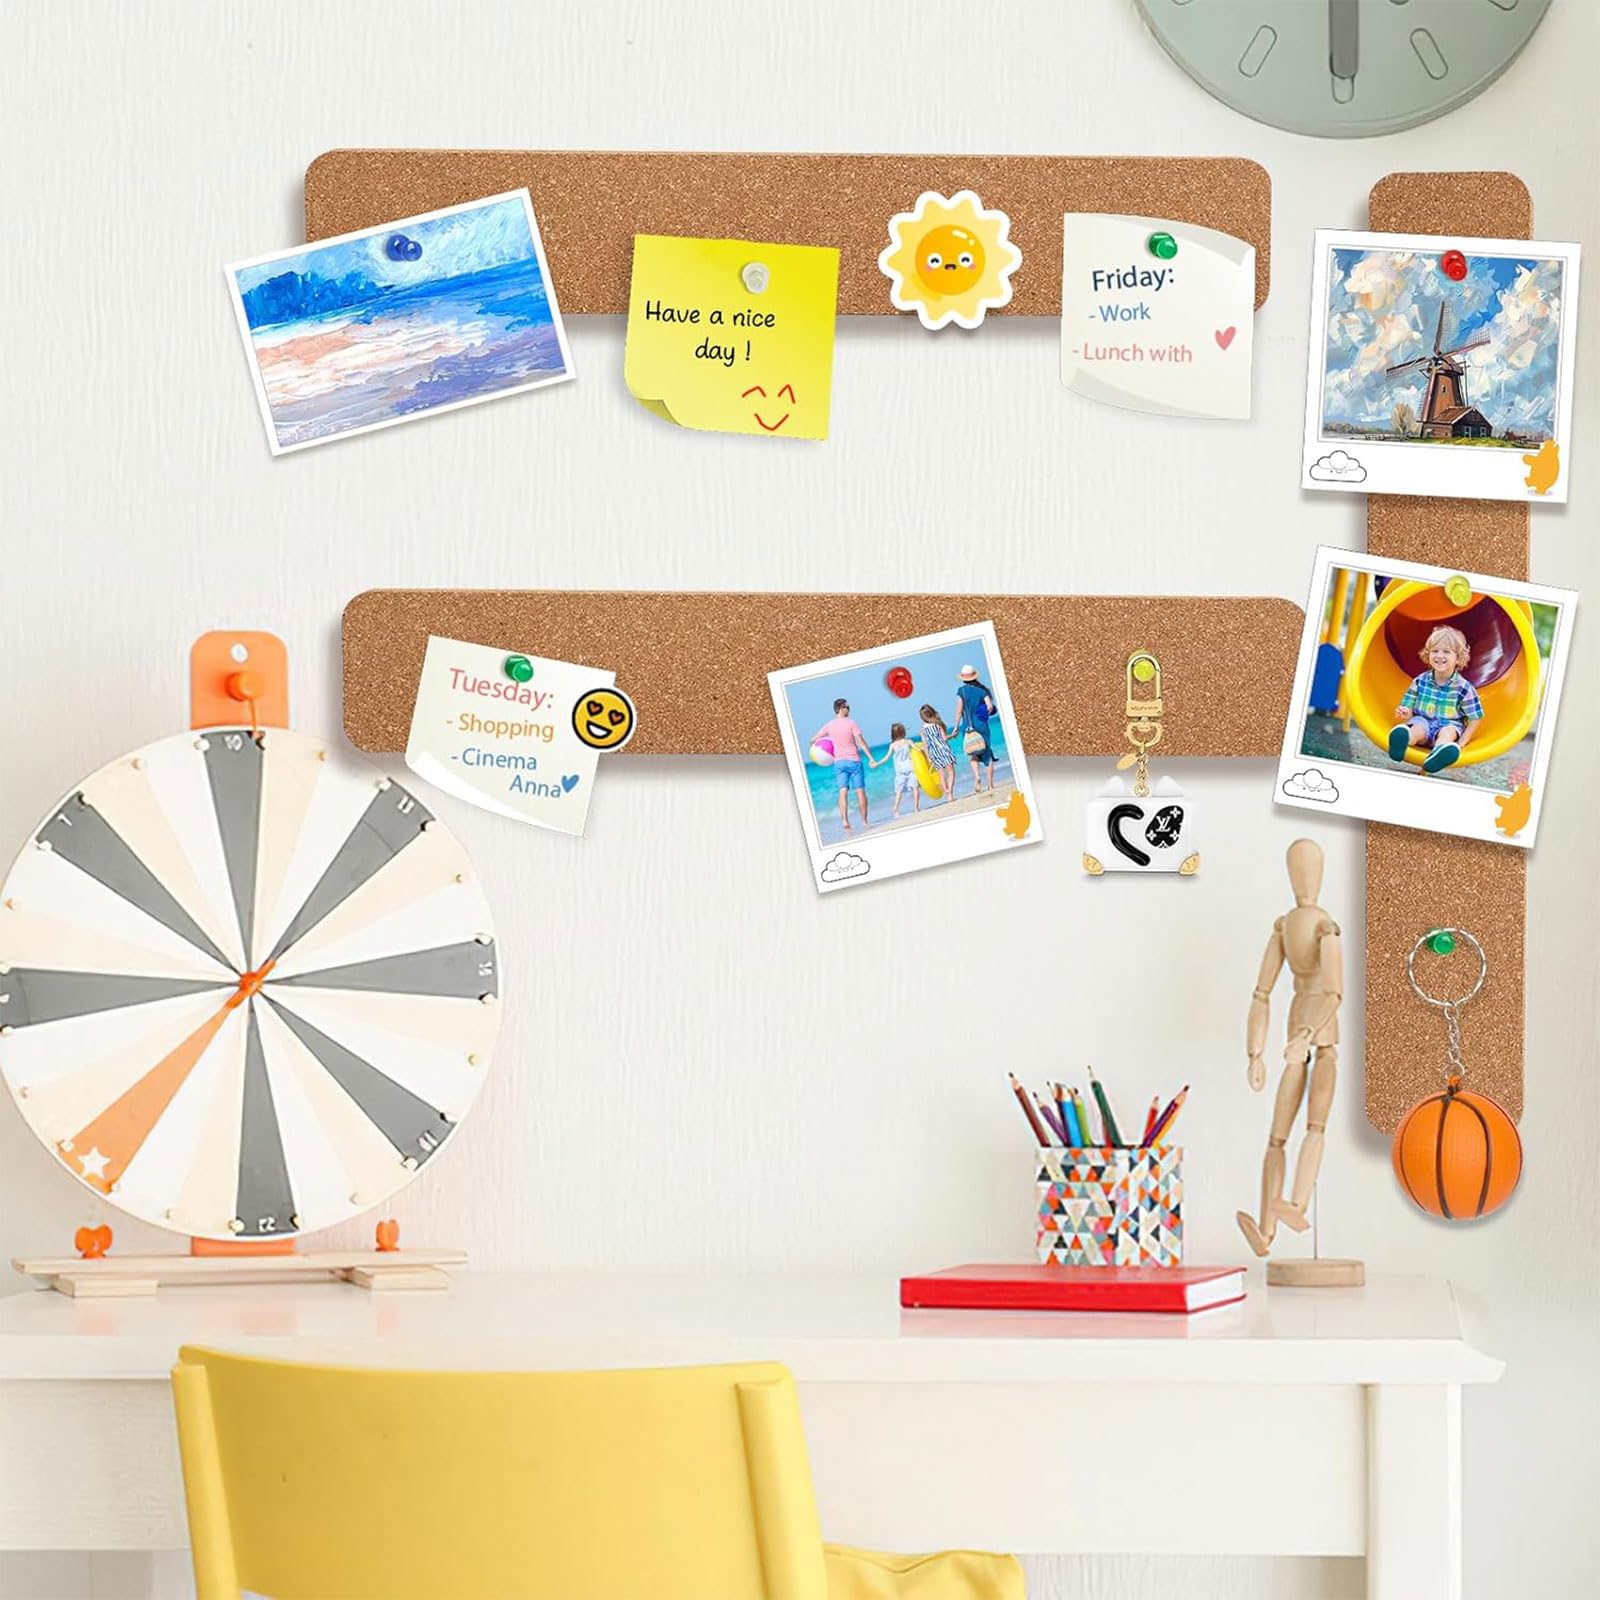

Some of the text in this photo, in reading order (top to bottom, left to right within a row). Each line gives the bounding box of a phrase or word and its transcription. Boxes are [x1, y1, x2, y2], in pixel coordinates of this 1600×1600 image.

[1092, 265, 1175, 292] Friday:
[646, 300, 776, 327] Have a nice
[695, 337, 735, 367] day
[1084, 343, 1144, 362] Lunch
[1150, 344, 1193, 364] with
[449, 667, 554, 712] Tuesday:
[458, 713, 555, 743] Shopping
[462, 748, 537, 770] Cinema
[509, 775, 561, 798] Anna
